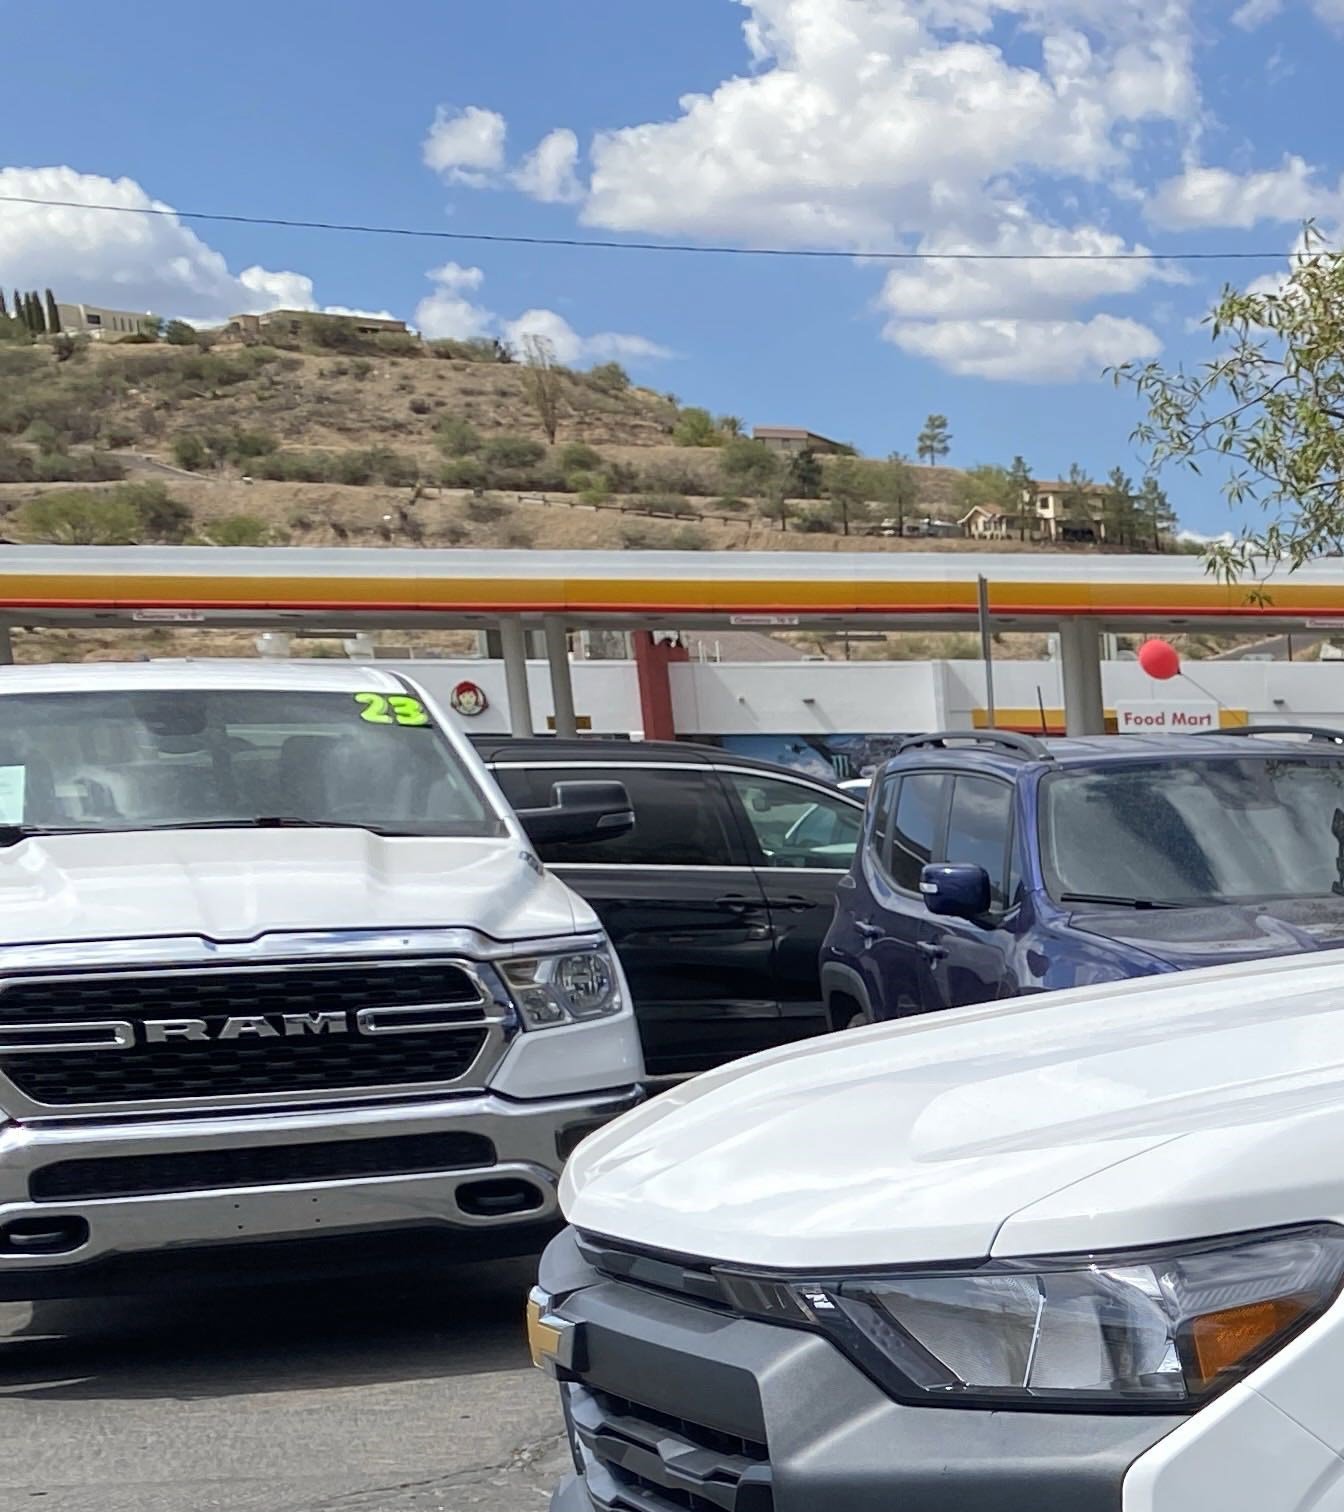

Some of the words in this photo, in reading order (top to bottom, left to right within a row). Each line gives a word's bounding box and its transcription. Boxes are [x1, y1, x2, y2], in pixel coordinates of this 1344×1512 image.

[354, 692, 428, 725] 23
[1124, 711, 1165, 726] Food
[1172, 712, 1212, 726] Mart
[143, 1011, 348, 1042] RAM
